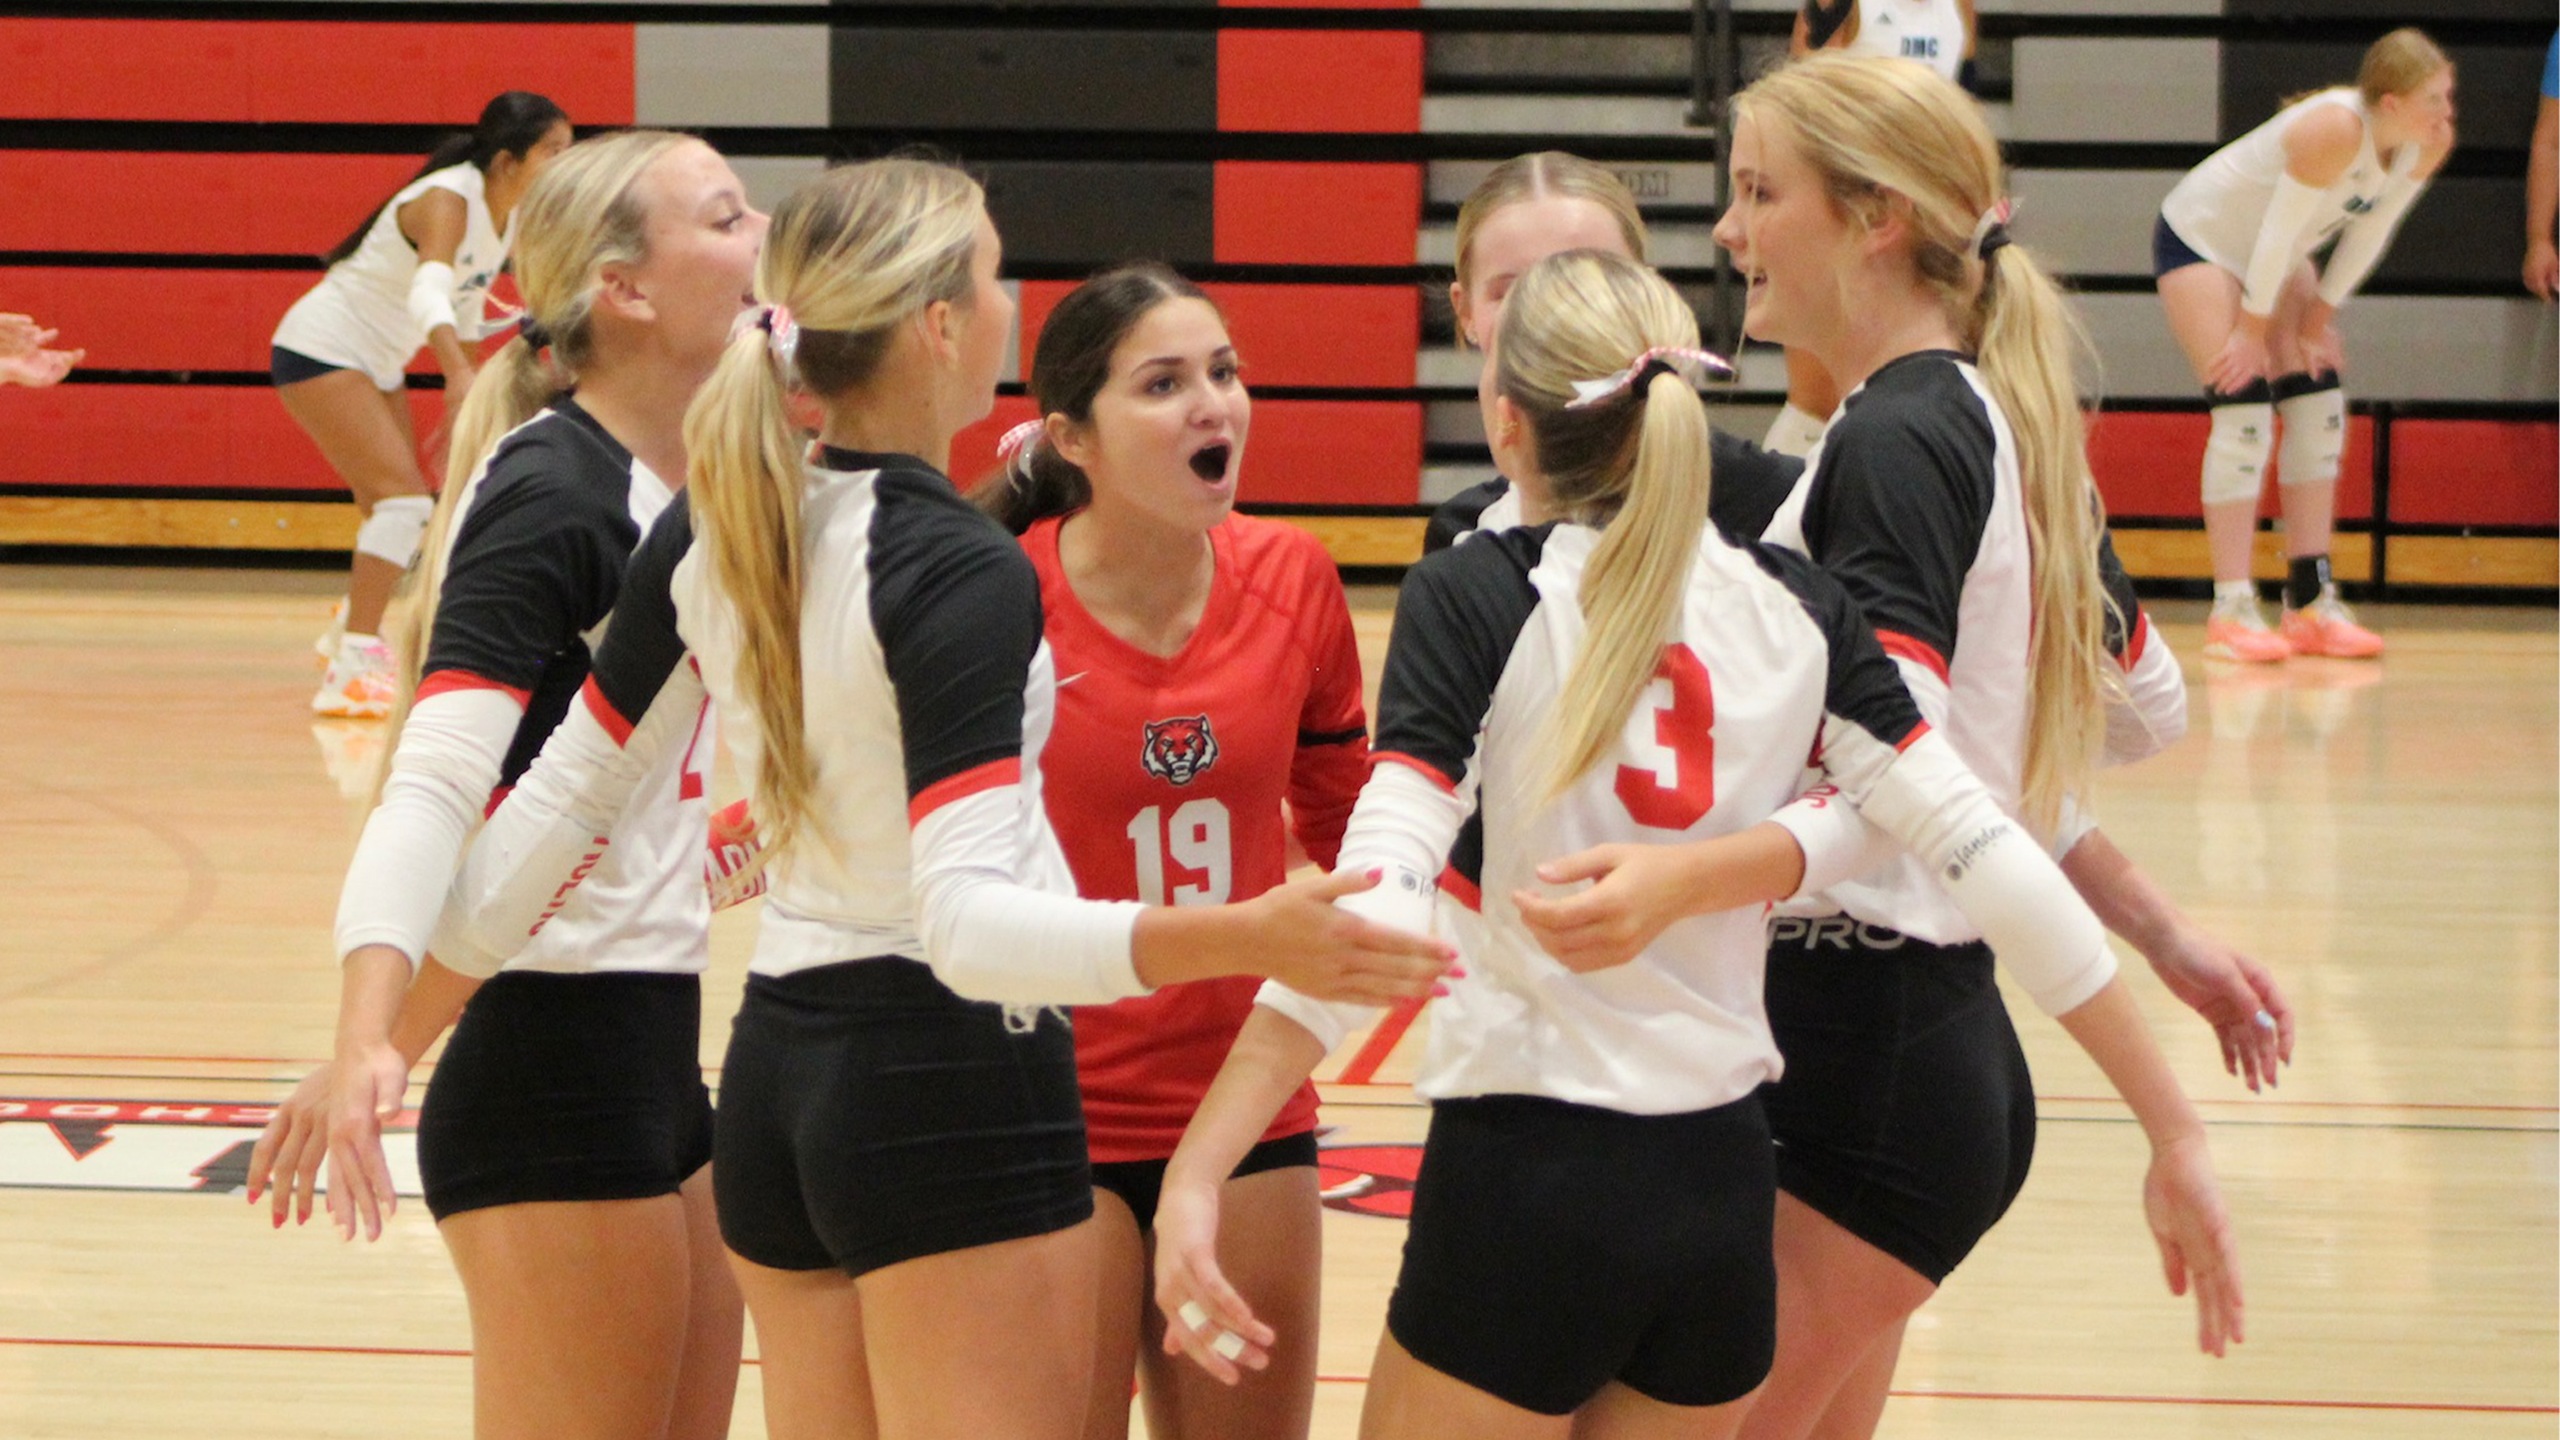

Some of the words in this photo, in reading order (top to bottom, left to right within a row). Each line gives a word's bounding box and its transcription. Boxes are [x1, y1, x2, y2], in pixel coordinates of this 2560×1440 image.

[1613, 641, 1715, 831] 3
[1126, 796, 1233, 907] 19
[1764, 917, 1908, 951] PRO
